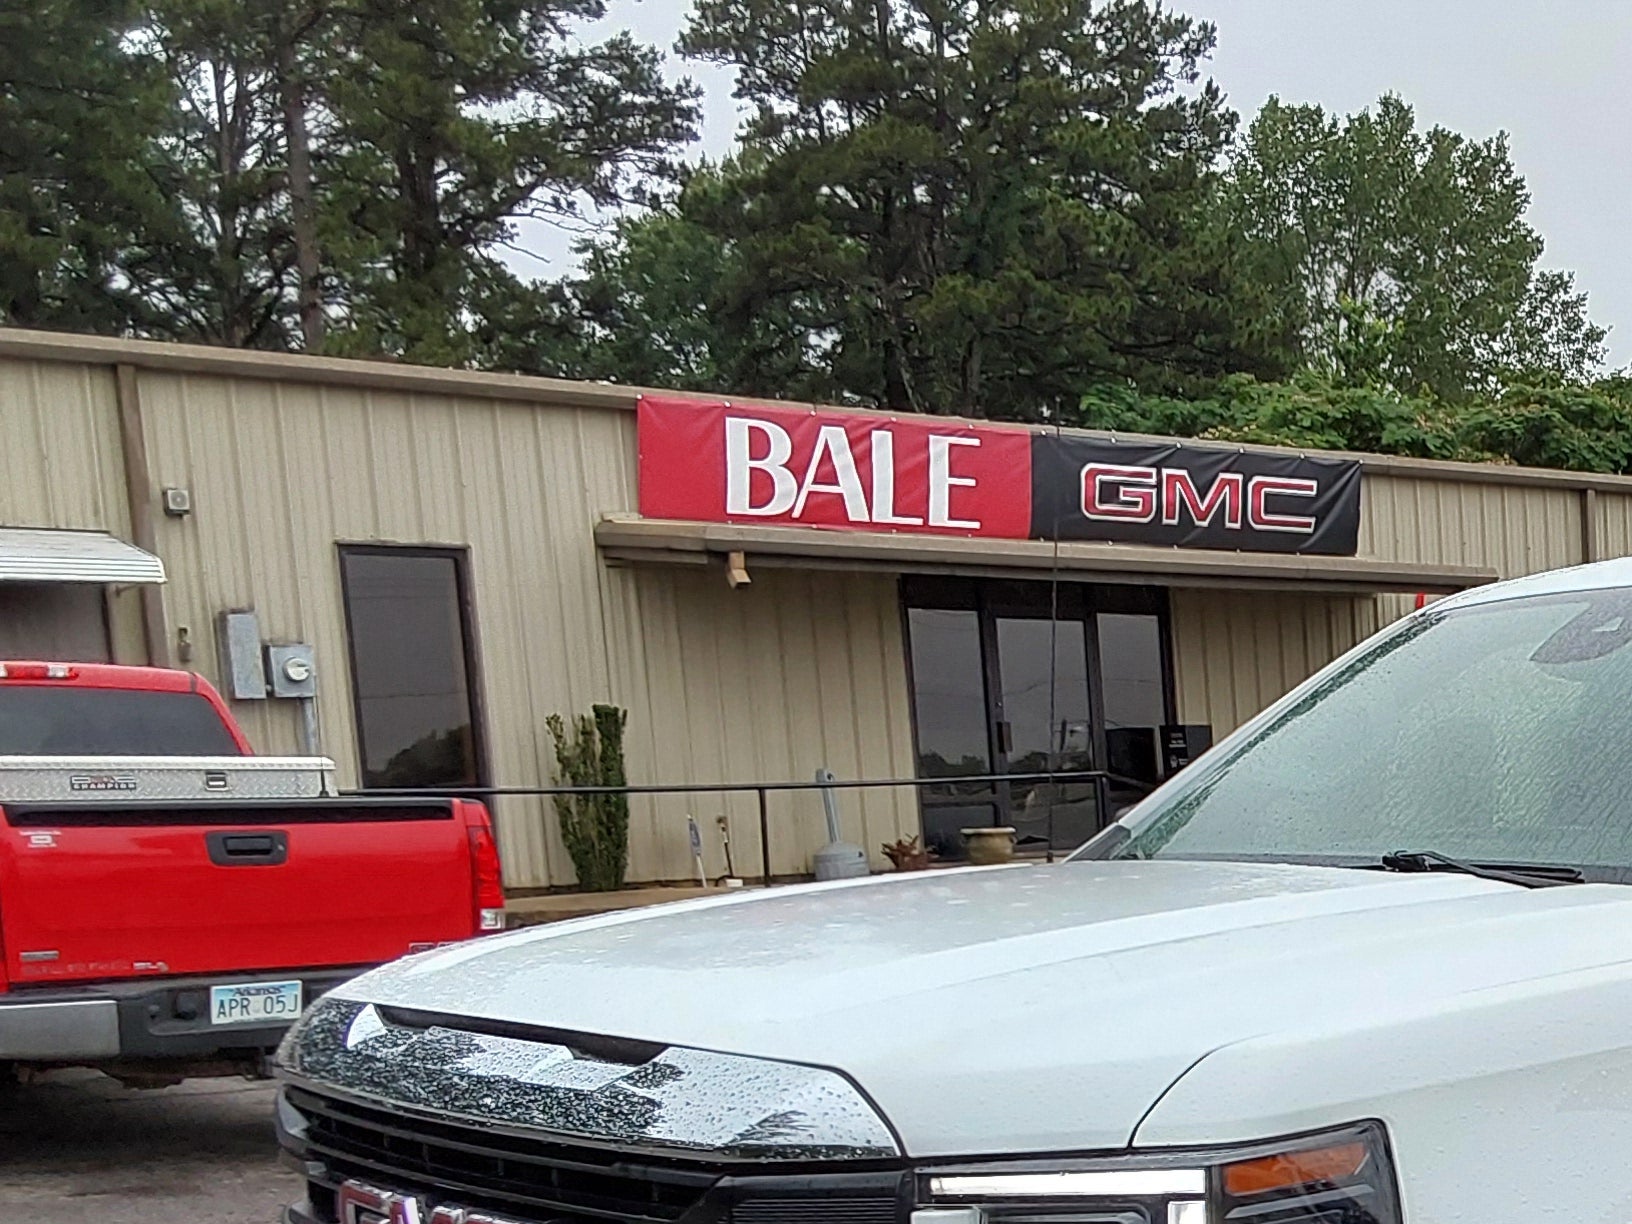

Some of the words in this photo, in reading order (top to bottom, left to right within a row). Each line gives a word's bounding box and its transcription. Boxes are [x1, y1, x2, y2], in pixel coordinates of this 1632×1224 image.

[725, 416, 981, 529] BALE
[1081, 462, 1317, 534] GMC
[217, 997, 251, 1018] APR
[263, 993, 298, 1015] 05J
